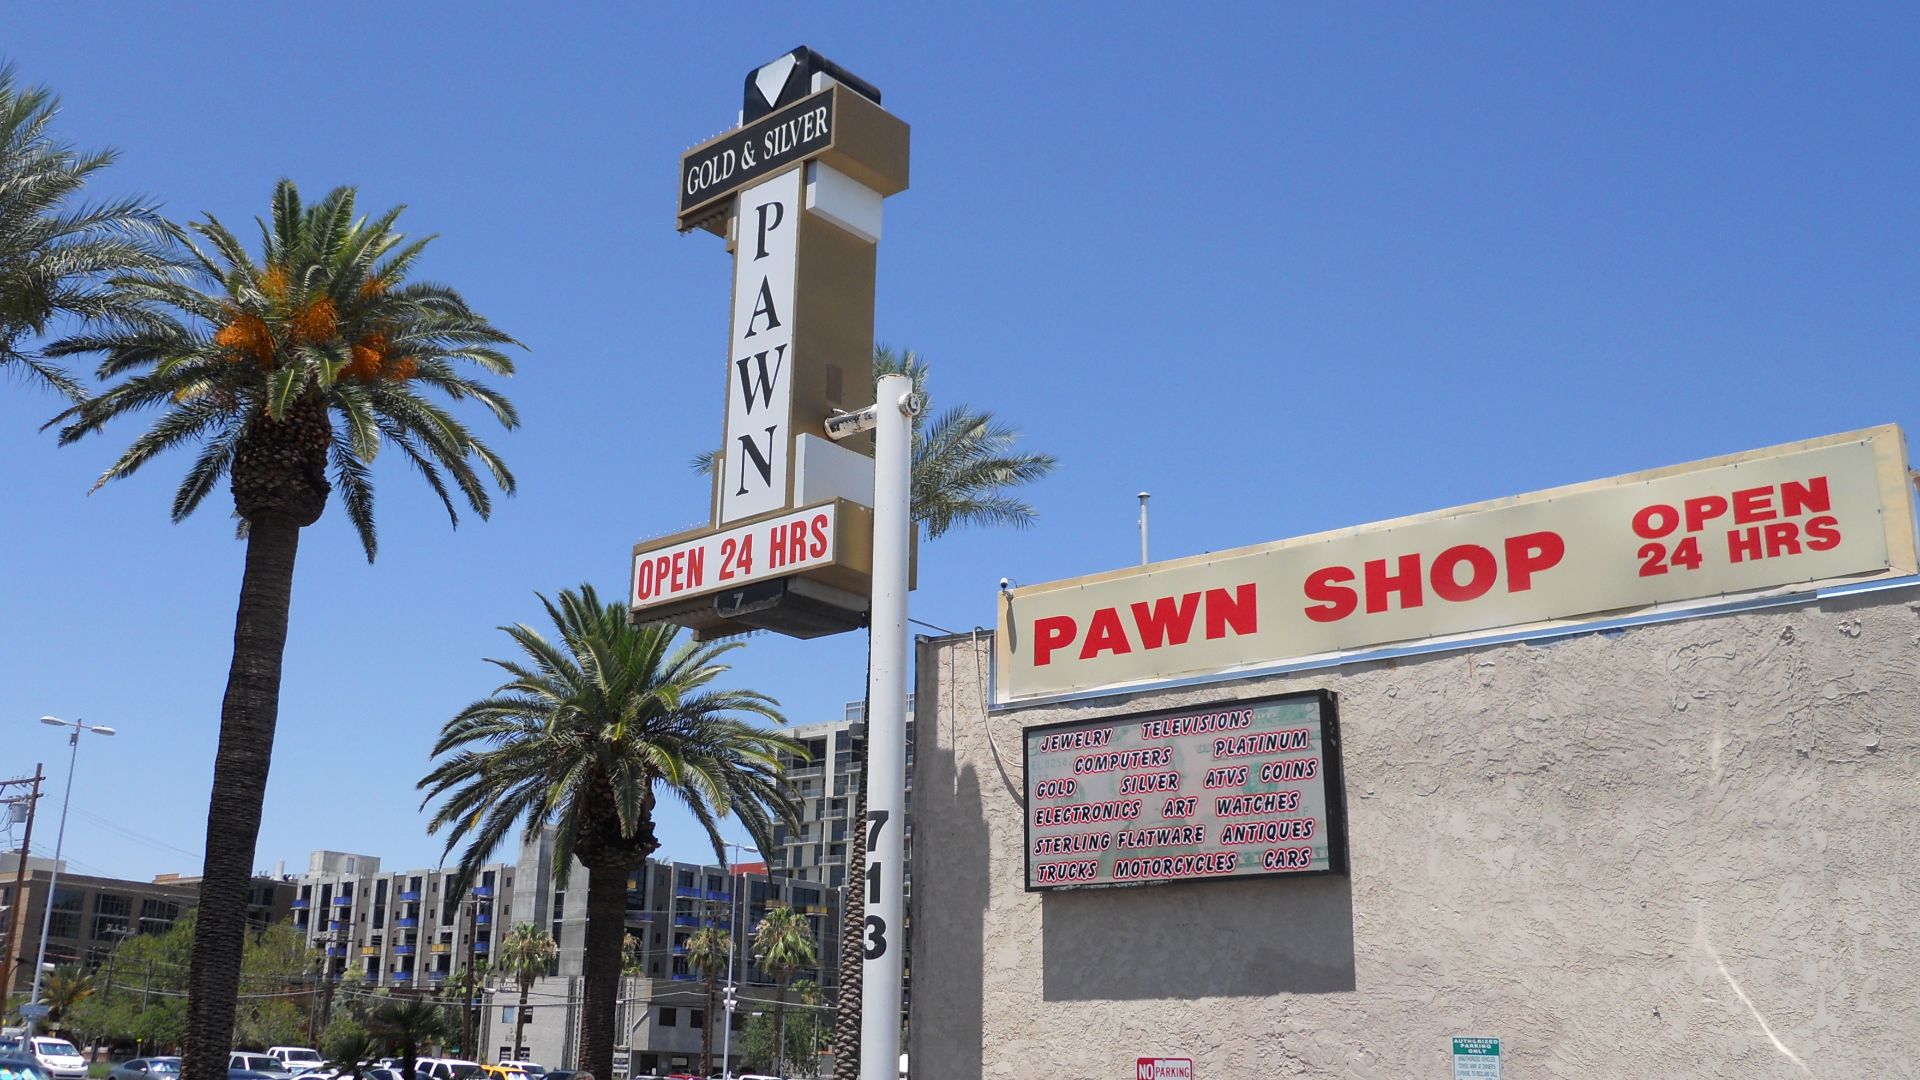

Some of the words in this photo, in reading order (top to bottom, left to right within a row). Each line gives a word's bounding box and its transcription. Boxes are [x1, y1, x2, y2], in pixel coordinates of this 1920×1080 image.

[687, 149, 736, 195] GOLD
[741, 140, 756, 171] &
[763, 106, 828, 160] SILVER
[736, 200, 788, 497] PAWN
[1632, 476, 1831, 539] OPEN
[637, 546, 704, 600] OPEN
[718, 533, 753, 581] 24
[769, 514, 829, 569] HRS
[1637, 536, 1703, 577] 24
[1727, 516, 1841, 563] HRS
[1034, 583, 1257, 667] PAWN
[1303, 531, 1565, 623] SHOP
[1041, 728, 1113, 752] JEWELRY
[1142, 709, 1253, 739] TELEVISIONS
[1074, 748, 1172, 773] COMPUTERS
[1214, 730, 1308, 757] PLATINUM
[1036, 778, 1077, 798] GOLD
[1121, 772, 1179, 795] SILVER
[1204, 767, 1248, 788] ATVS
[1260, 759, 1318, 782] COINS
[1035, 801, 1142, 826] ELECTRONICS
[1163, 797, 1198, 818] ART
[1216, 792, 1300, 816] WATCHES
[1034, 832, 1111, 855] STERLING
[1117, 825, 1205, 848] FLATWARE
[1222, 820, 1314, 845] ANTIQUES
[863, 810, 890, 960] 713
[1037, 861, 1098, 882] TRUCKS
[1113, 854, 1237, 879] MOTORCYCLES
[1264, 849, 1311, 869] CARS
[1139, 1064, 1153, 1080] NO
[1155, 1067, 1190, 1078] PARKING
